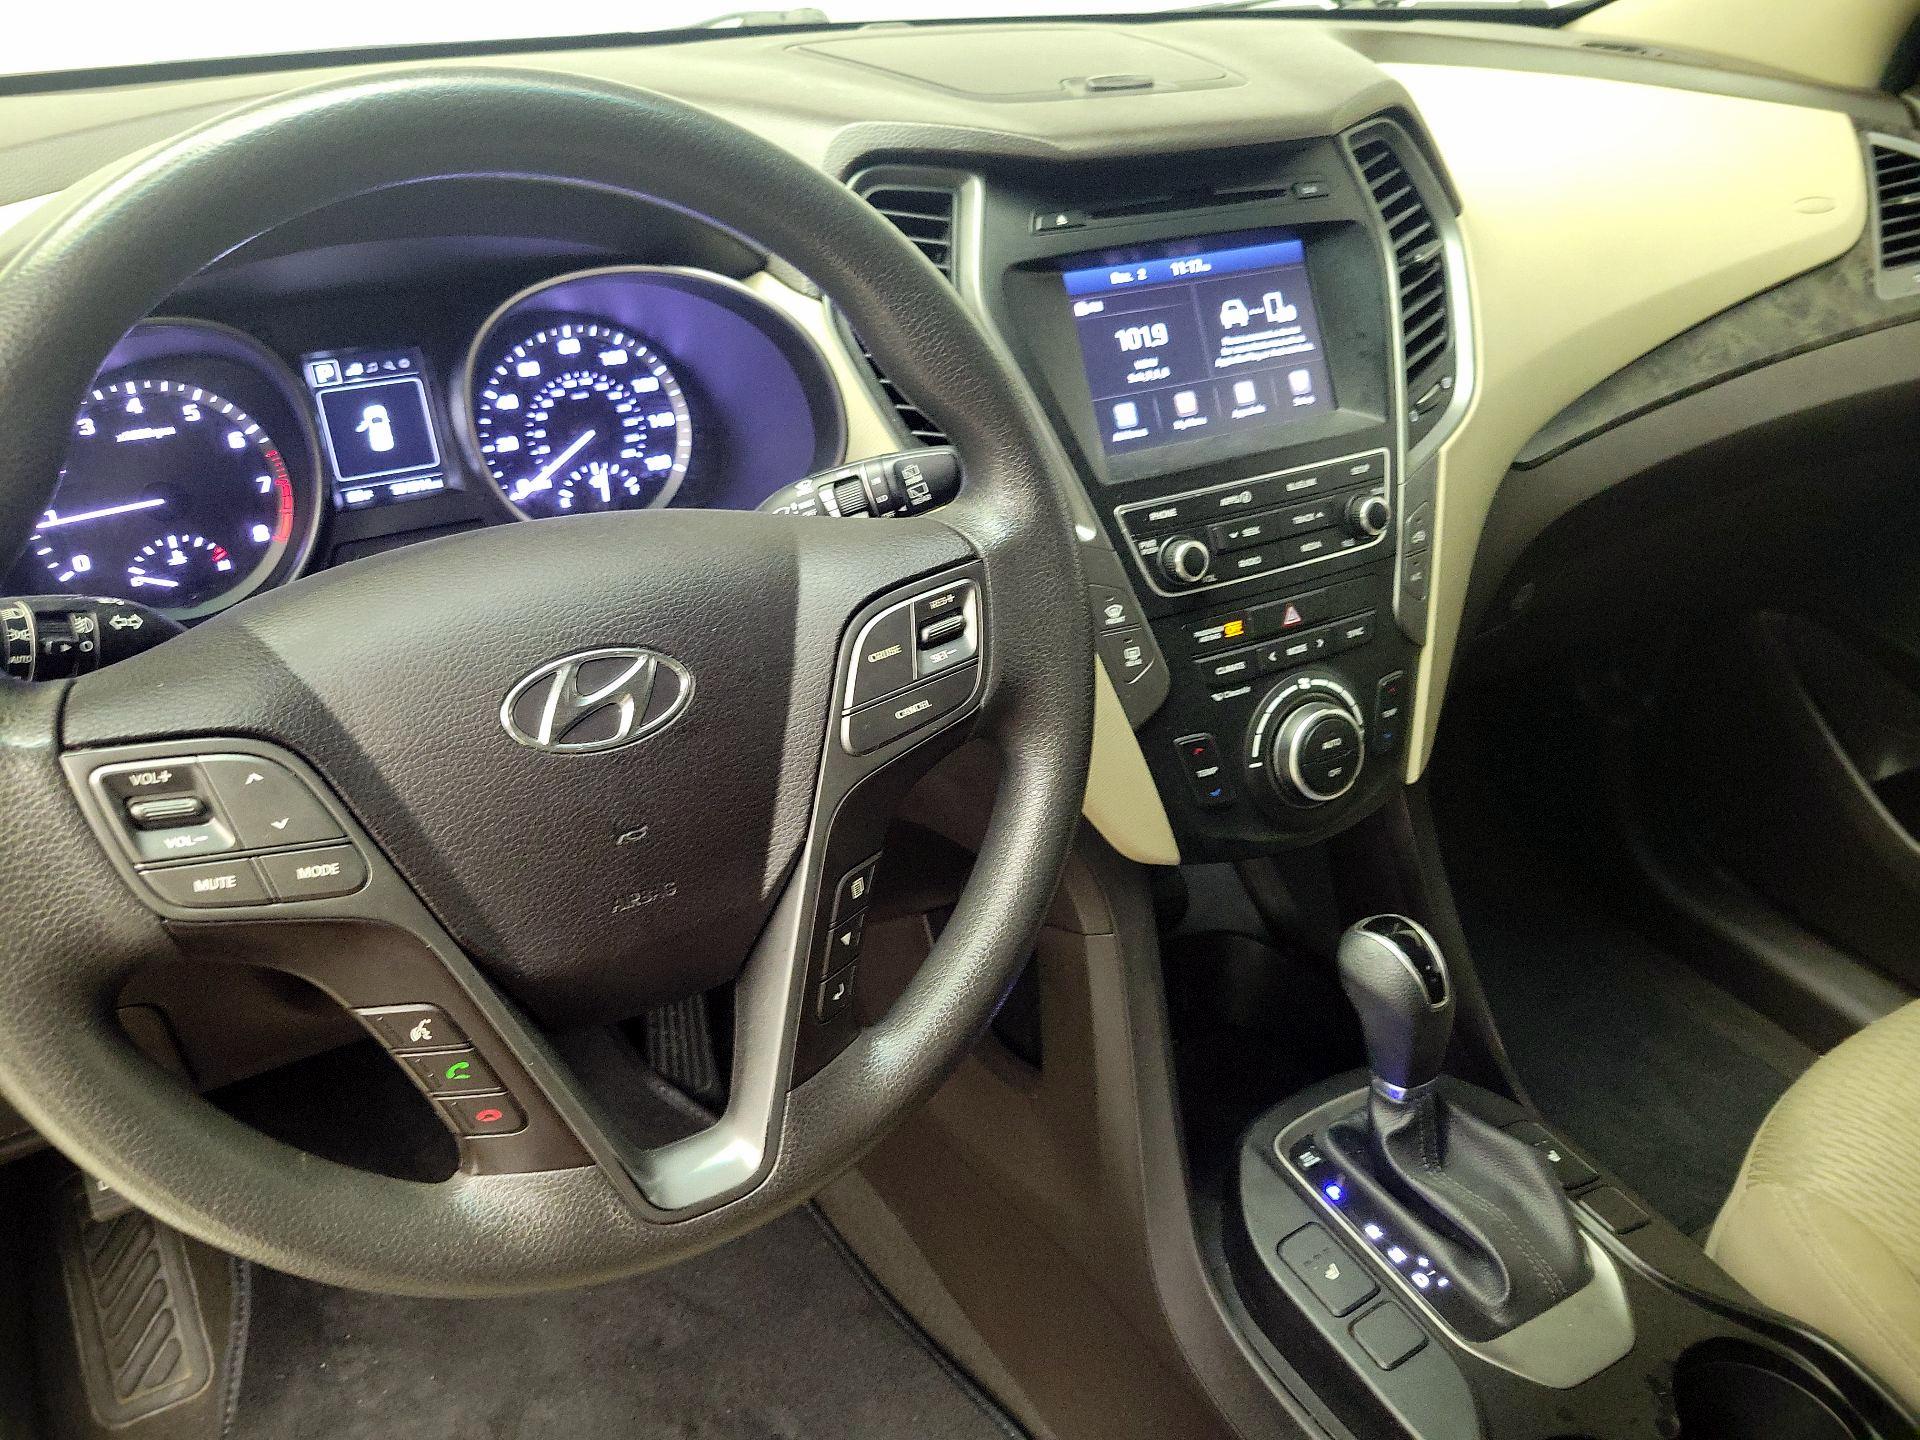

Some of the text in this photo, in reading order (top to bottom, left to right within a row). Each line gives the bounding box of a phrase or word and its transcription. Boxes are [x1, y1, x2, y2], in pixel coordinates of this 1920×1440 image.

[126, 398, 143, 414] 4
[183, 404, 201, 421] 5
[76, 418, 96, 436] 3
[228, 431, 246, 449] 6
[256, 476, 272, 494] 7
[72, 555, 91, 572] 0
[10, 656, 32, 664] AUTO
[894, 699, 933, 720] CANCEL
[128, 769, 172, 786] VOL+
[296, 863, 340, 880] MODE
[193, 875, 237, 893] MUTE
[1411, 1272, 1430, 1288] D
